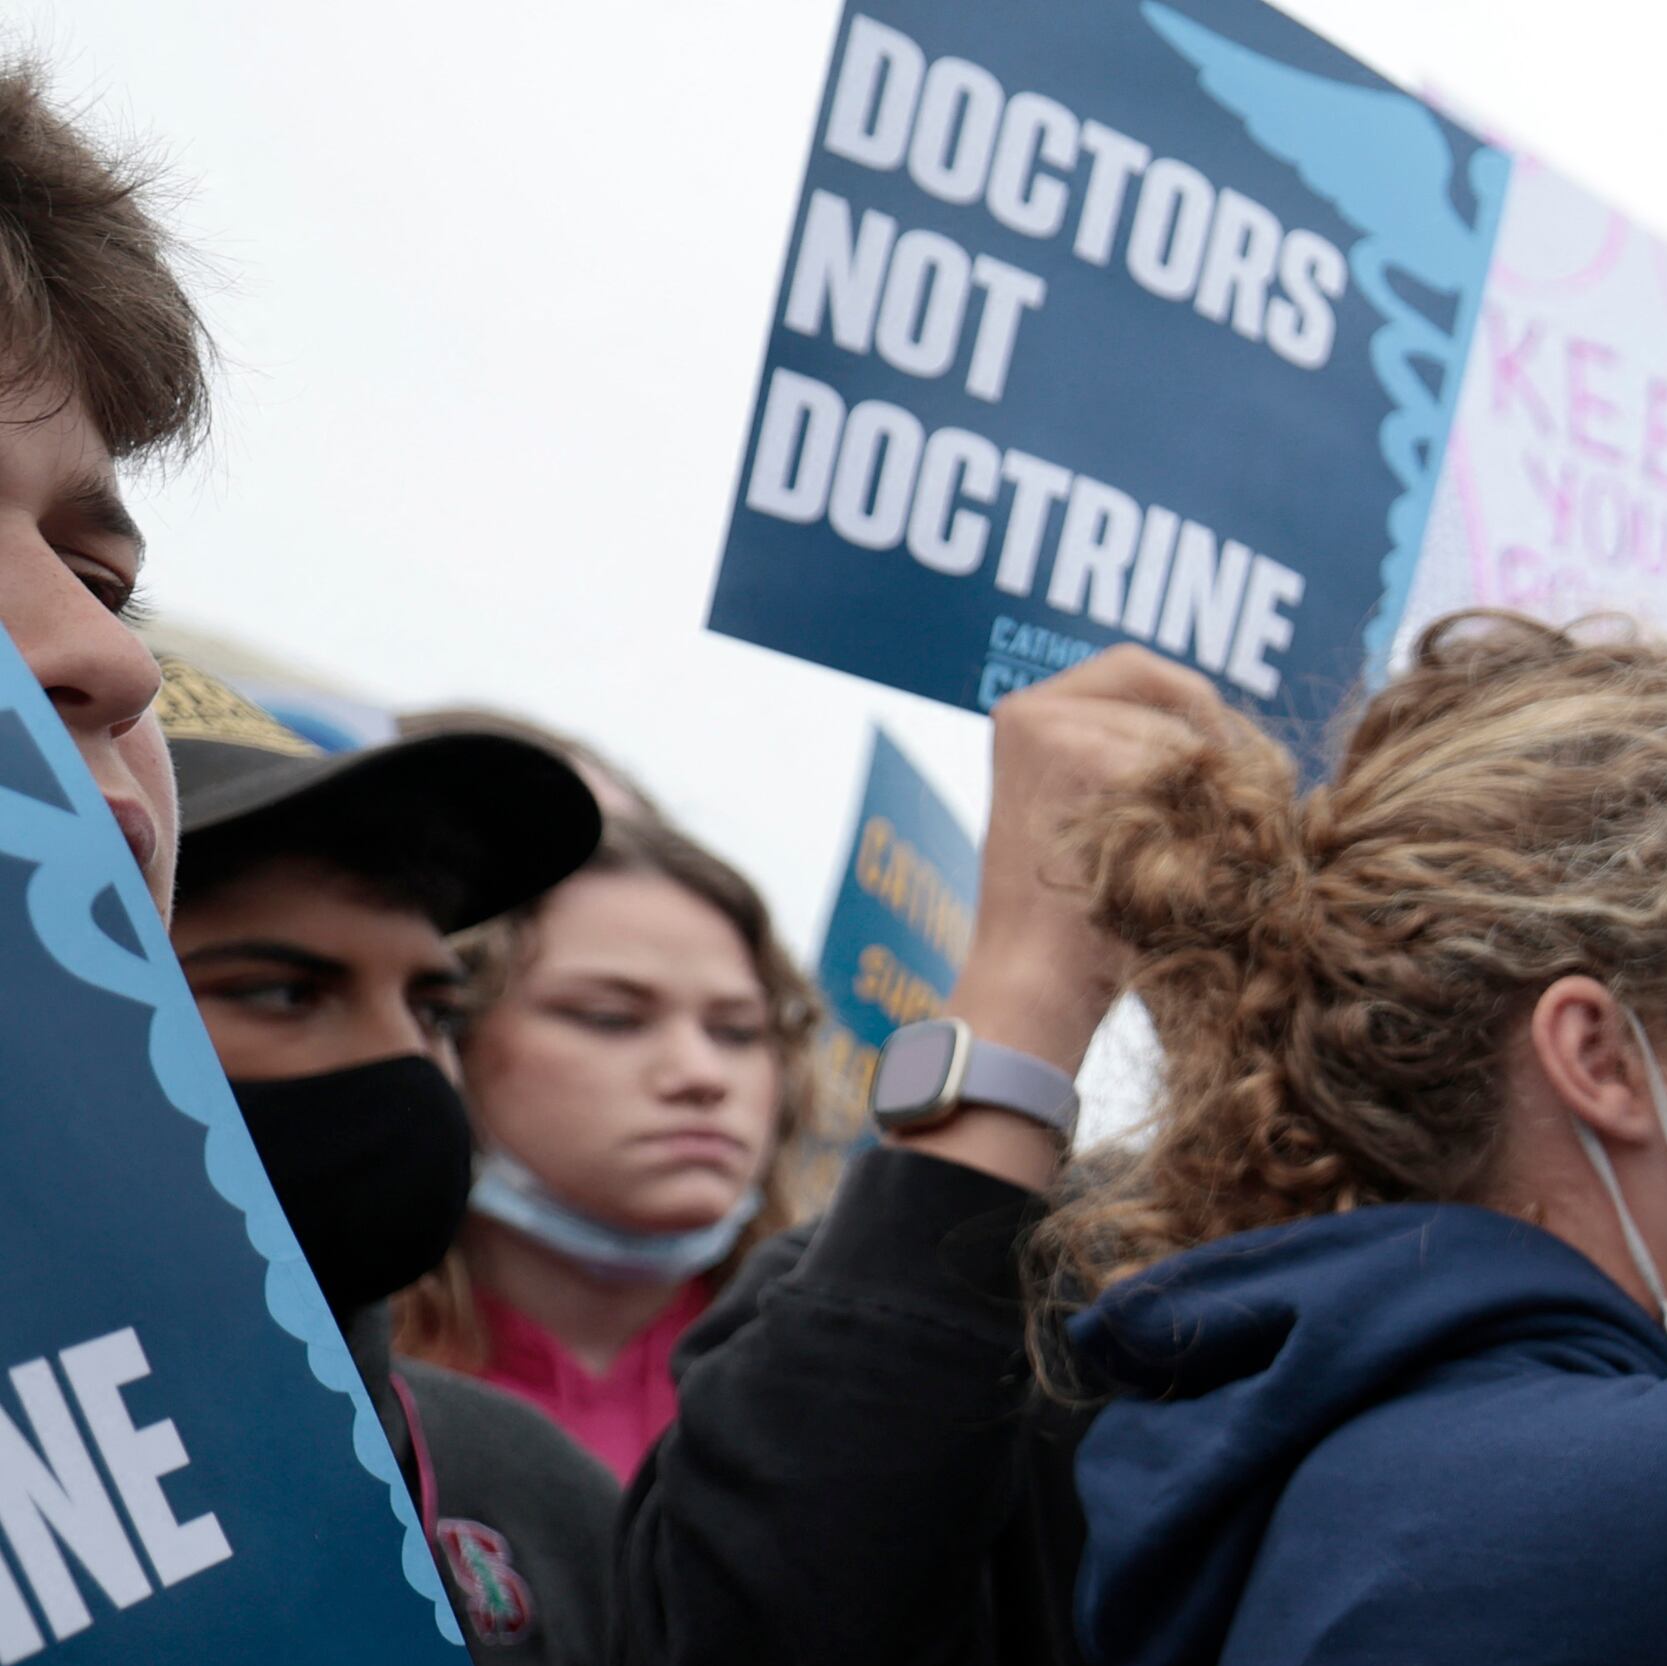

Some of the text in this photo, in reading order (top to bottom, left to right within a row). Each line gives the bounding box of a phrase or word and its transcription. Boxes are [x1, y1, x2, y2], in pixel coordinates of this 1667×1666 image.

[784, 187, 1047, 401] NOT
[824, 12, 1347, 370] DOCTORS
[745, 367, 1304, 698] DOCTRINE
